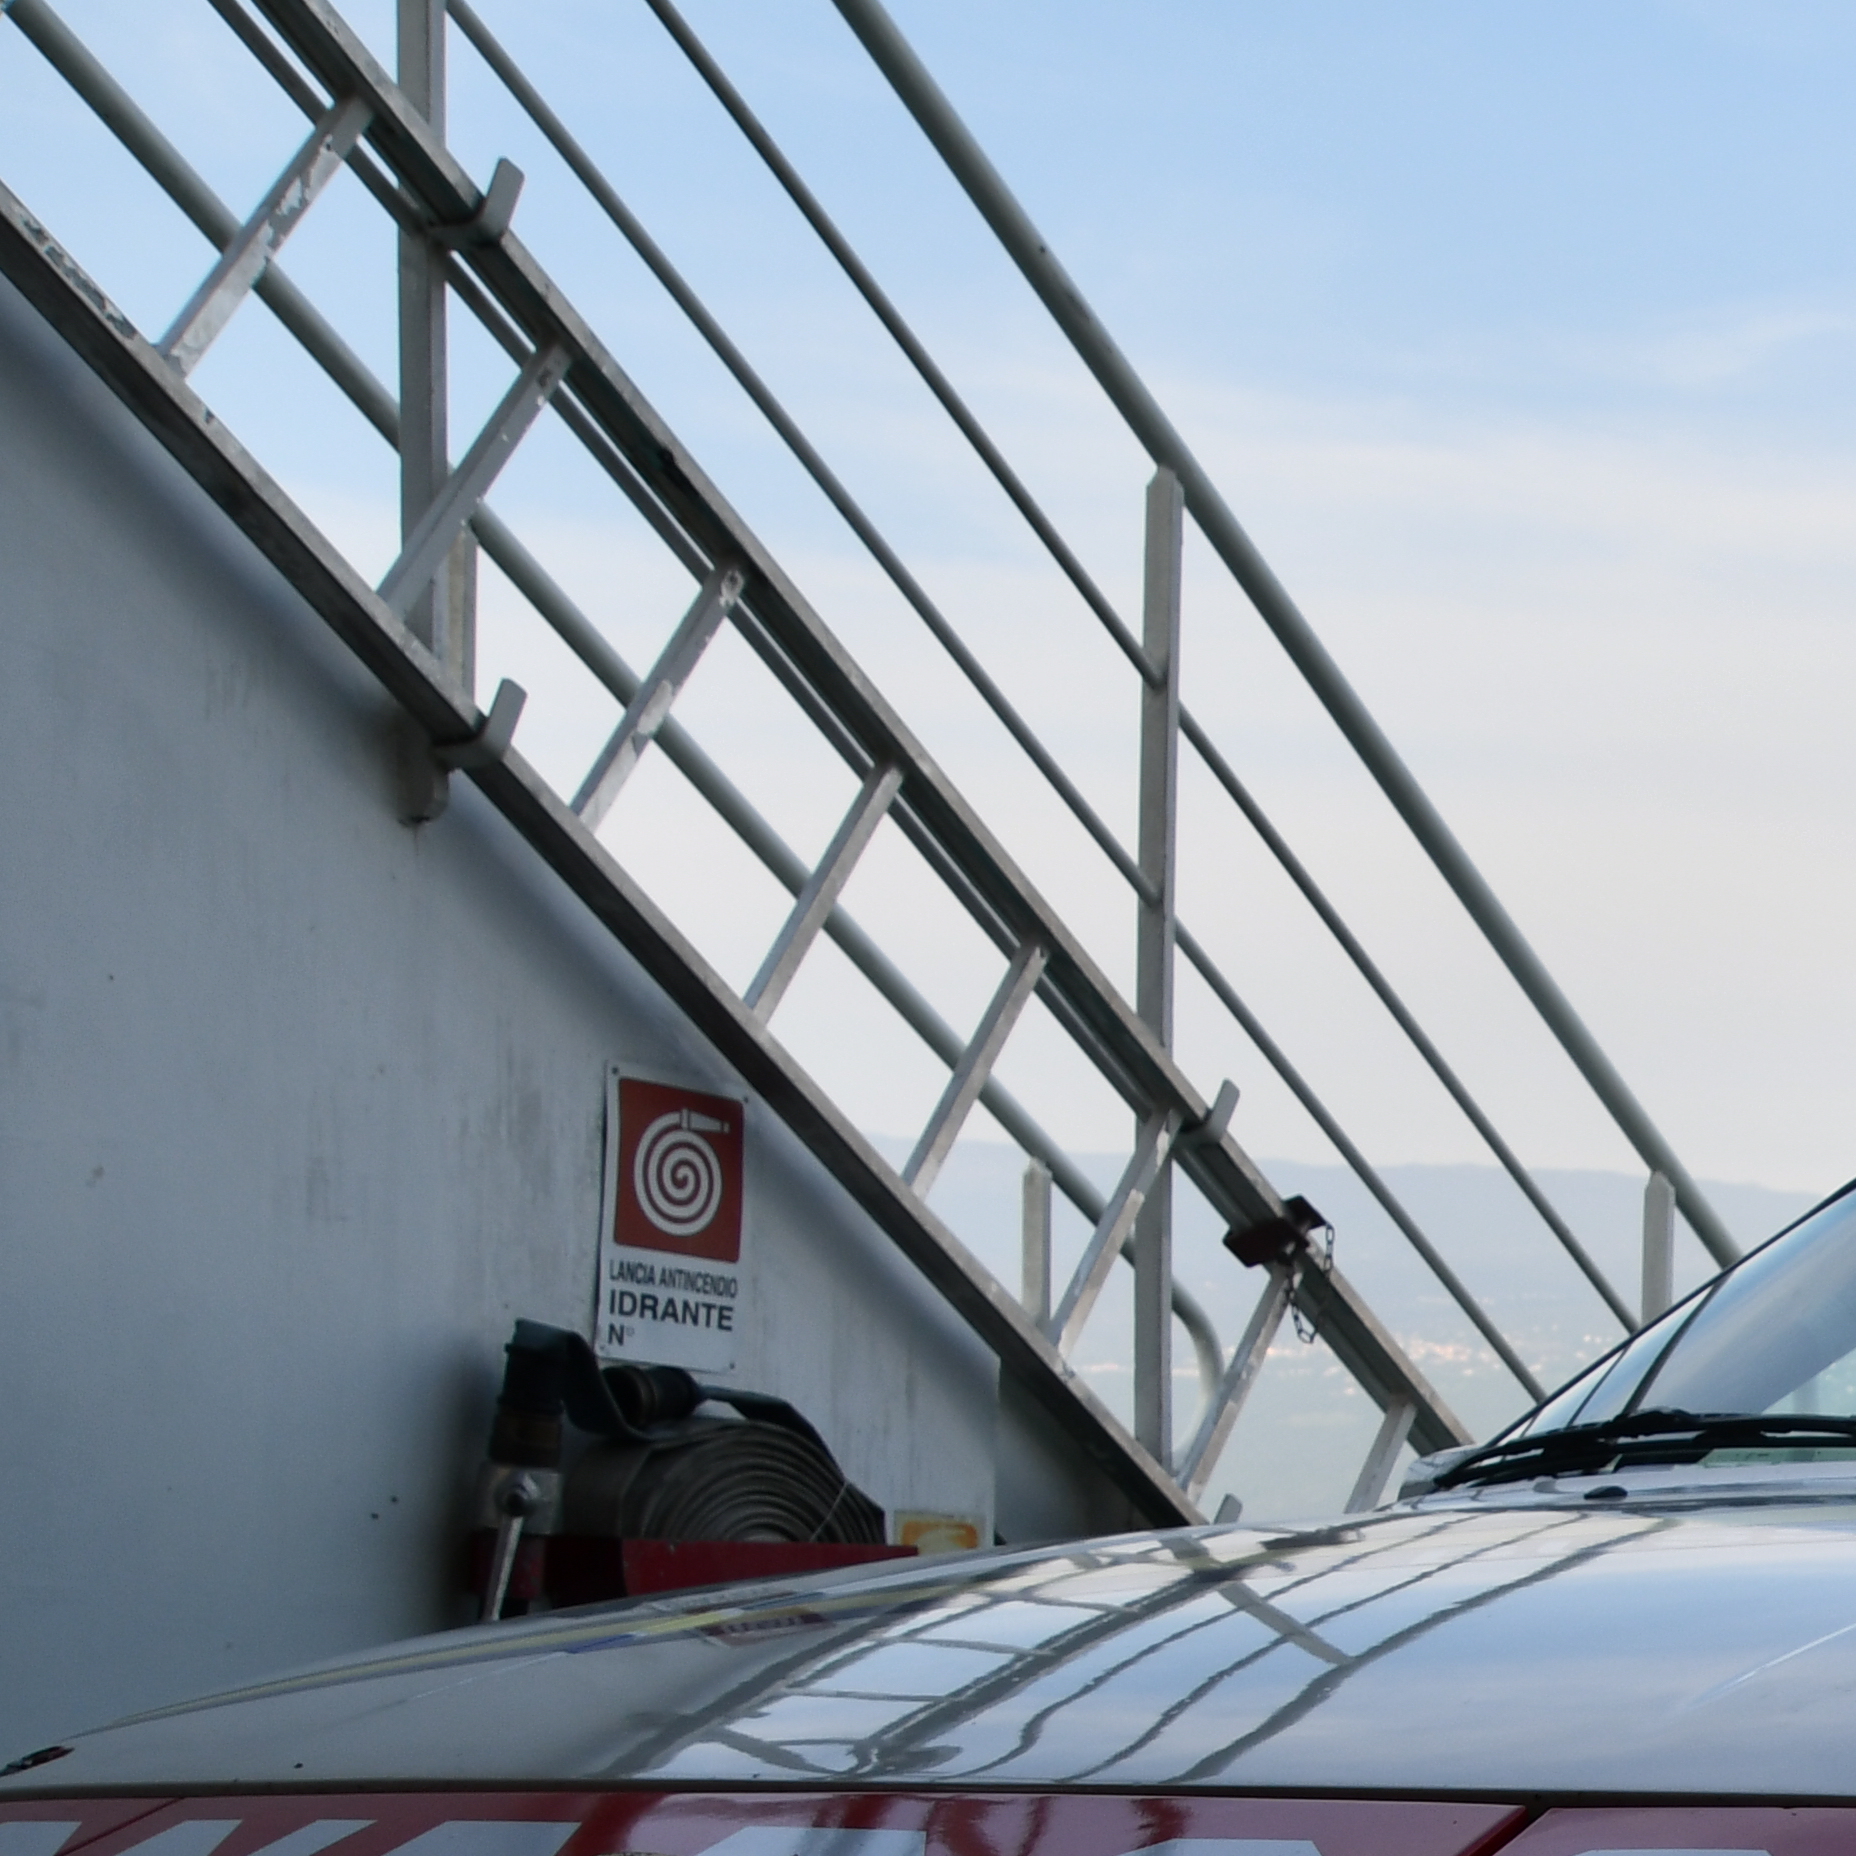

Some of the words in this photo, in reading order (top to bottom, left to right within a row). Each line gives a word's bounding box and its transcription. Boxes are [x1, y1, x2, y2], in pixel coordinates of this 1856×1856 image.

[609, 1260, 656, 1286] LANCIA
[659, 1267, 738, 1298] ANTINCENDIO
[609, 1289, 734, 1331] IDRANTE
